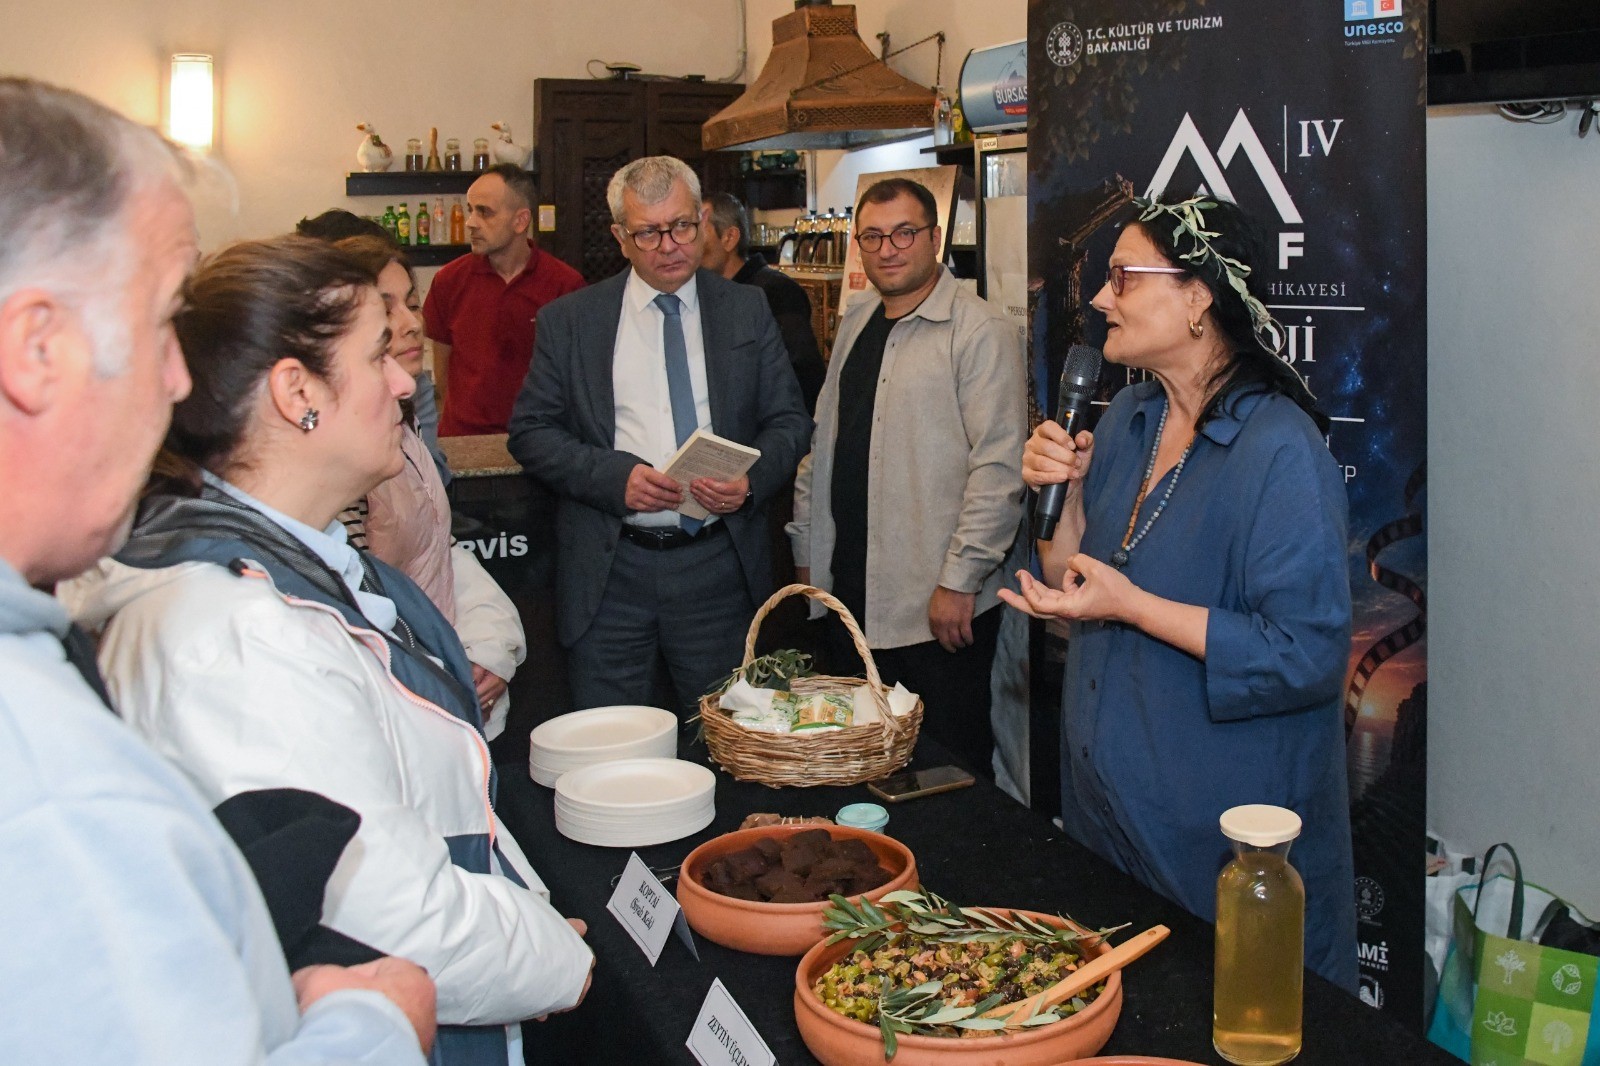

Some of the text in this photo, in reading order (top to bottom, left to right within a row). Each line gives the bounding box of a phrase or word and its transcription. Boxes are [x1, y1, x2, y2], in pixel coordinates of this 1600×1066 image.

[1087, 16, 1223, 40] T.C. KÜLTÜR VE TURİZM
[1344, 21, 1404, 37] unesco
[1087, 37, 1150, 55] BAKANLIĞI
[1298, 118, 1344, 157] IV
[1268, 281, 1346, 297] HİKAYESİ
[707, 1014, 733, 1049] ZEYTİN
